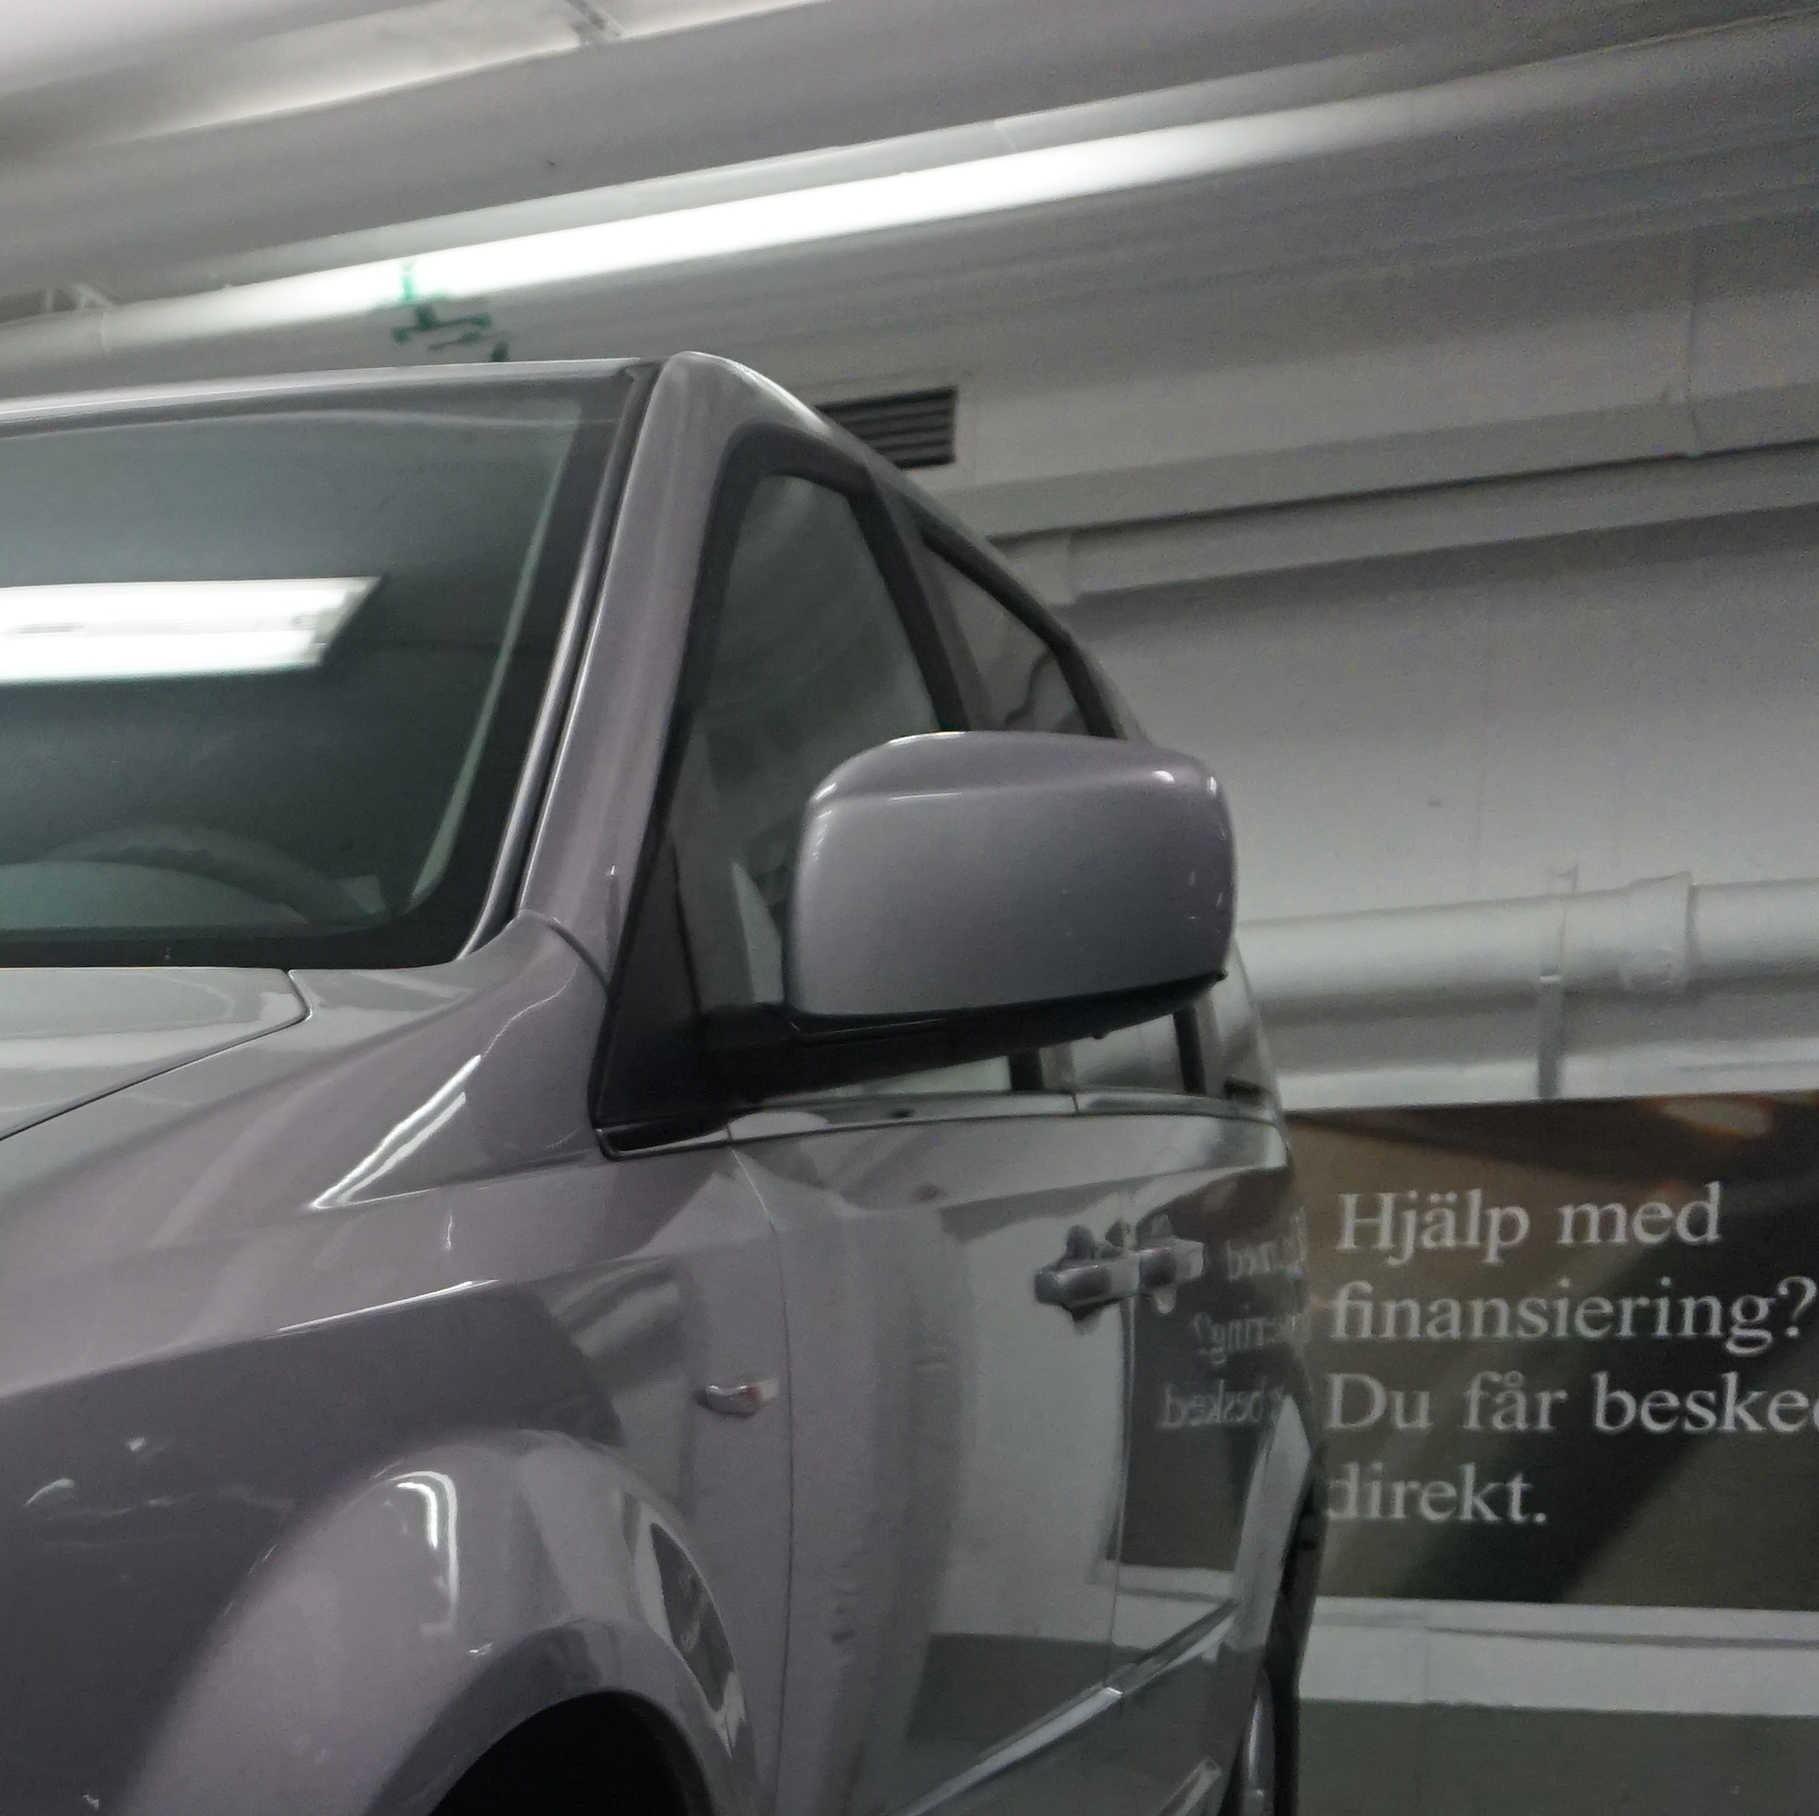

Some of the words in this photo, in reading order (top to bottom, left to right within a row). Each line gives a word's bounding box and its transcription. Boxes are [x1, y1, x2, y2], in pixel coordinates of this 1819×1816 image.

[1335, 1188, 1531, 1266] Hjälp
[1557, 1181, 1723, 1245] med
[1329, 1276, 1818, 1356] finansiering?
[1324, 1373, 1432, 1432] Du
[1463, 1371, 1567, 1432] får
[1592, 1371, 1819, 1434] beske
[1327, 1462, 1548, 1524] direkt.
